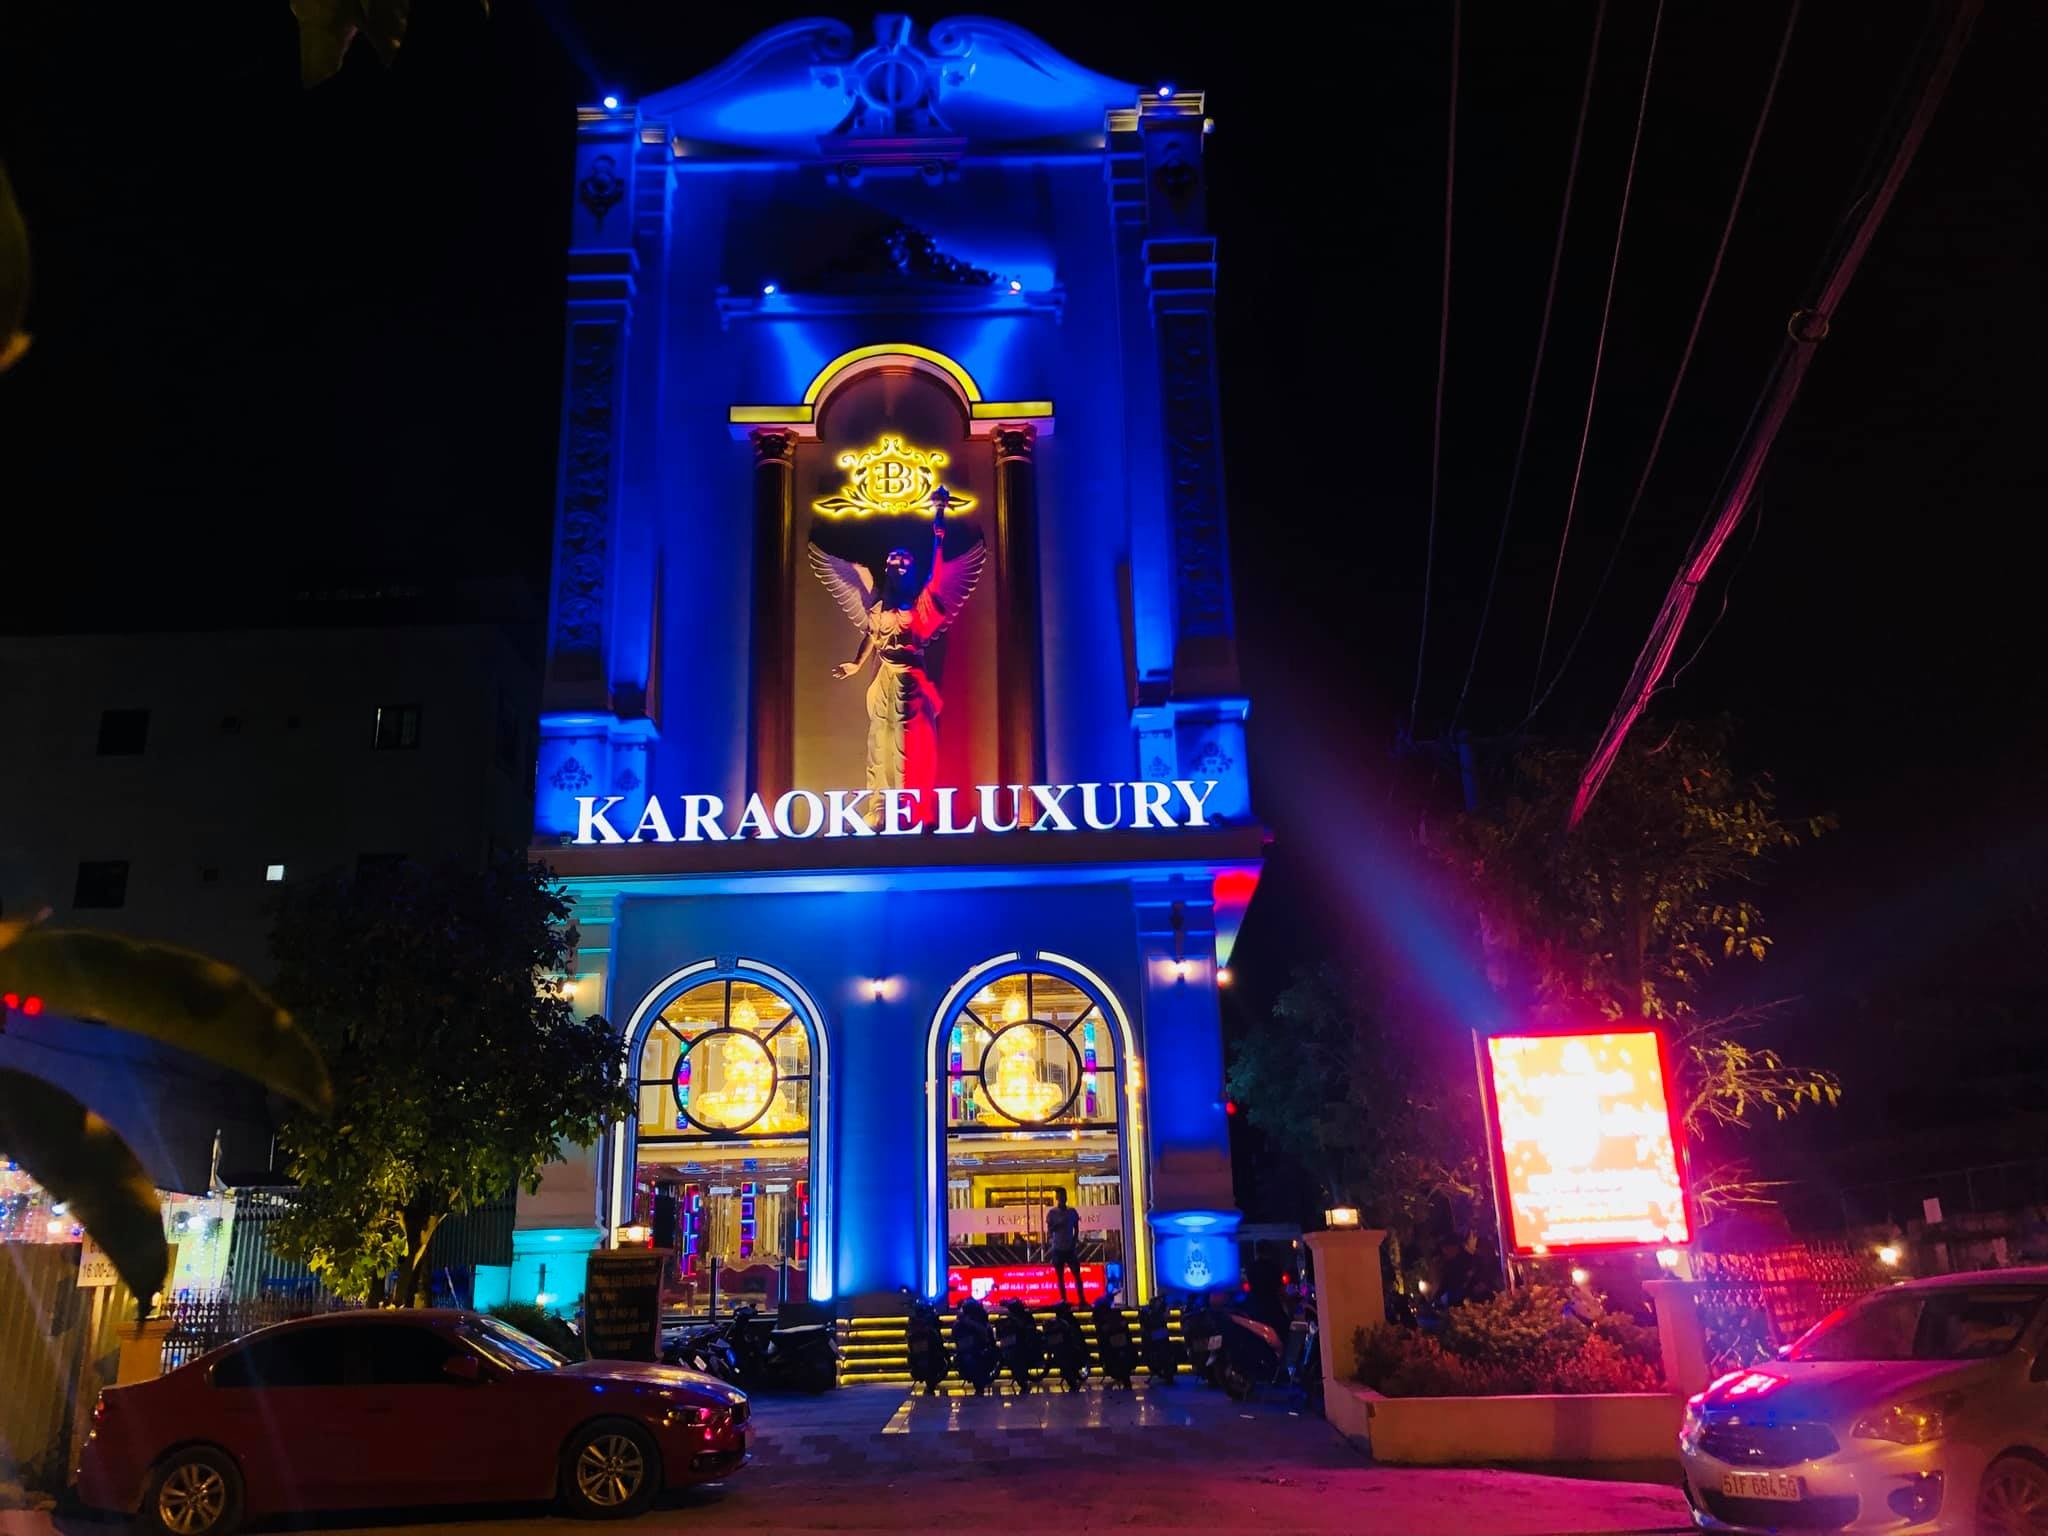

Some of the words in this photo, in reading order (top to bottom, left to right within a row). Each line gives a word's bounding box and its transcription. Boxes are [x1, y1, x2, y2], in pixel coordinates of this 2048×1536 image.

[572, 789, 923, 844] KARAOKE
[933, 780, 1218, 834] LUXURY
[1723, 1475, 1746, 1494] 51F
